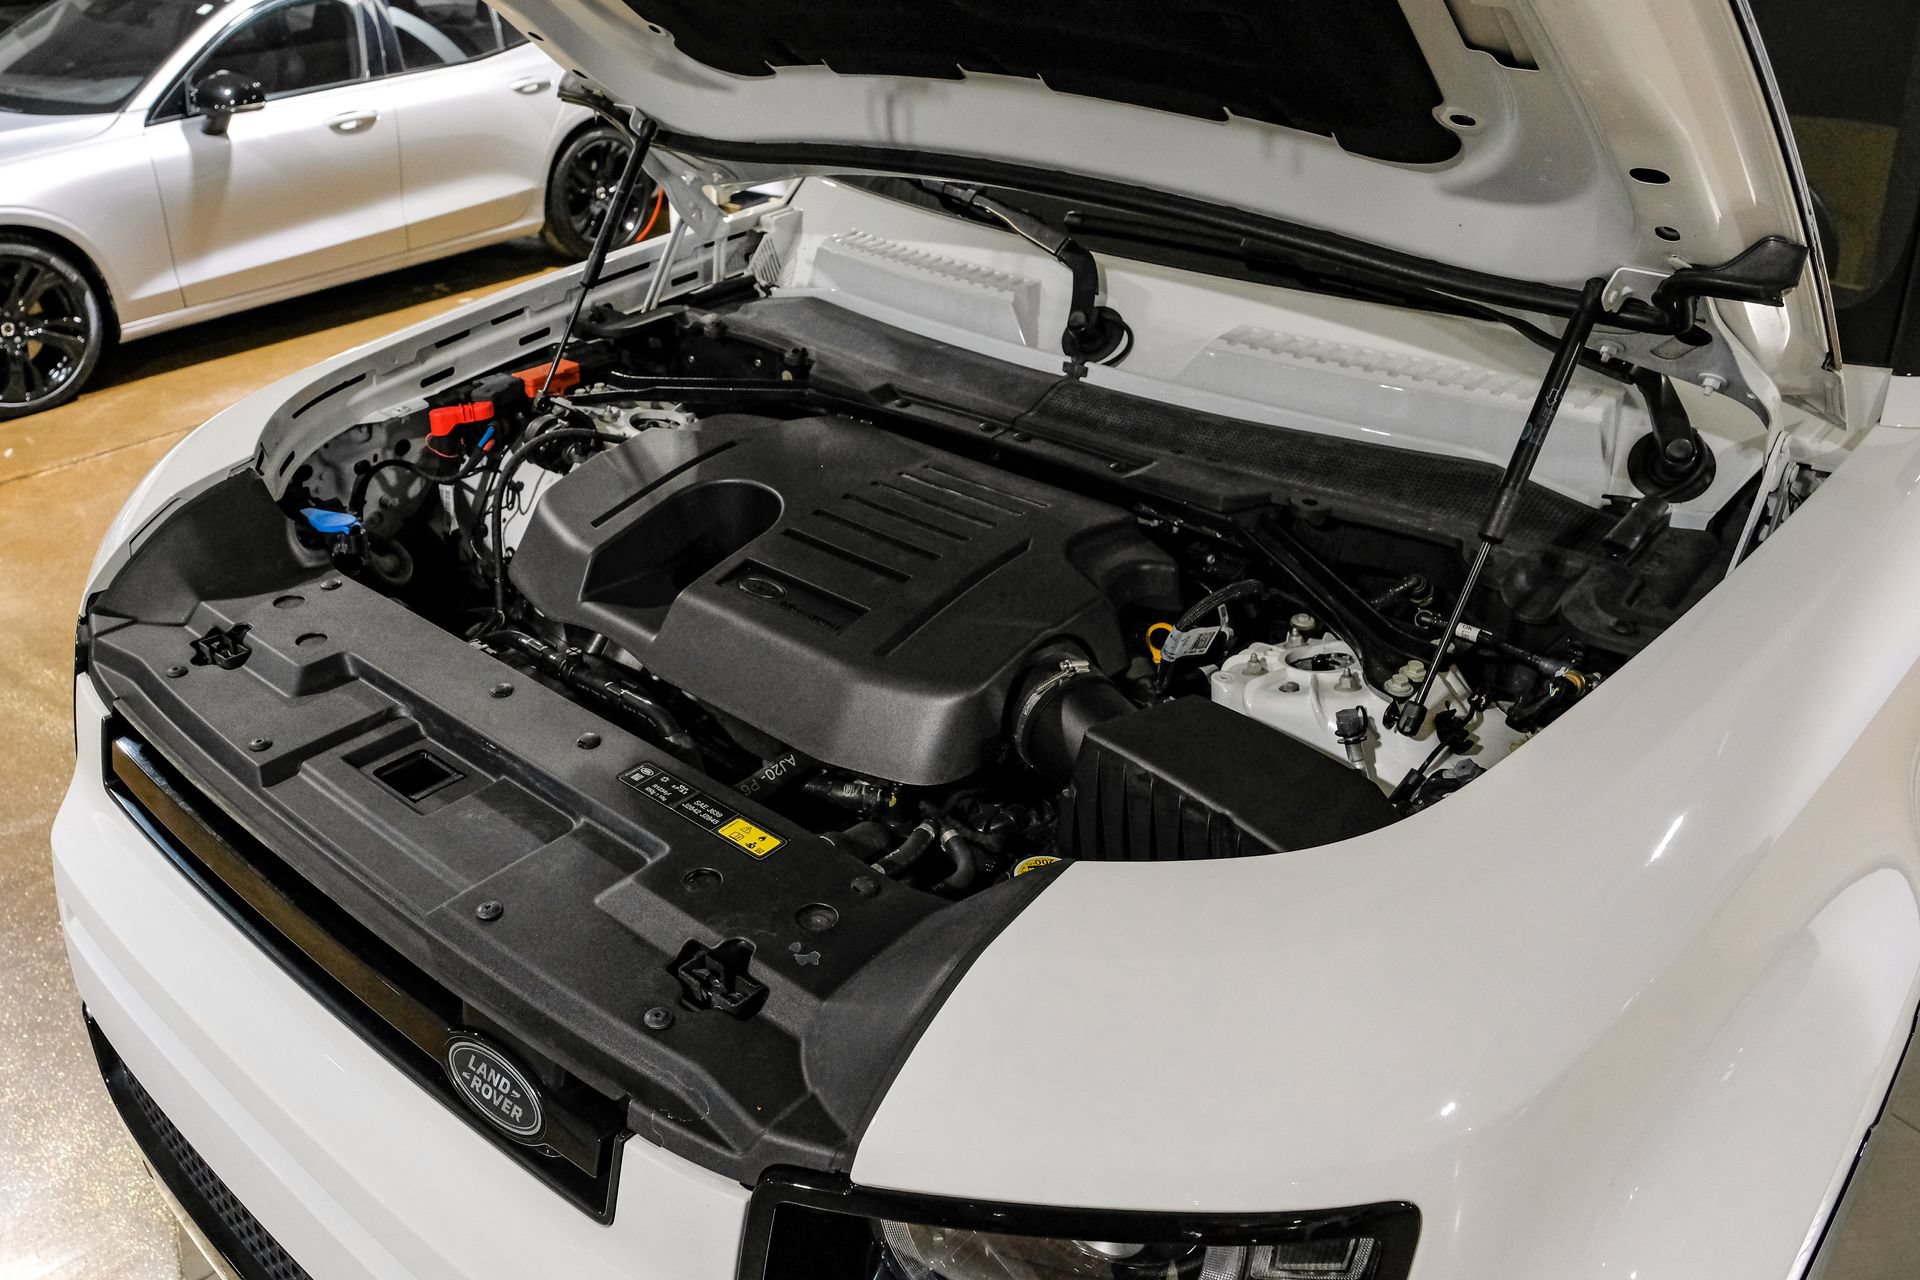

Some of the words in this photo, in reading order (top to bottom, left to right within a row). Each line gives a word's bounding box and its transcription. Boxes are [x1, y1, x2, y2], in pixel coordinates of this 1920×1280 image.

[694, 799, 710, 810] SAE
[706, 808, 723, 818] J639
[699, 812, 720, 825] J2845
[467, 1053, 511, 1096] LAND
[470, 1074, 524, 1123] ROVER
